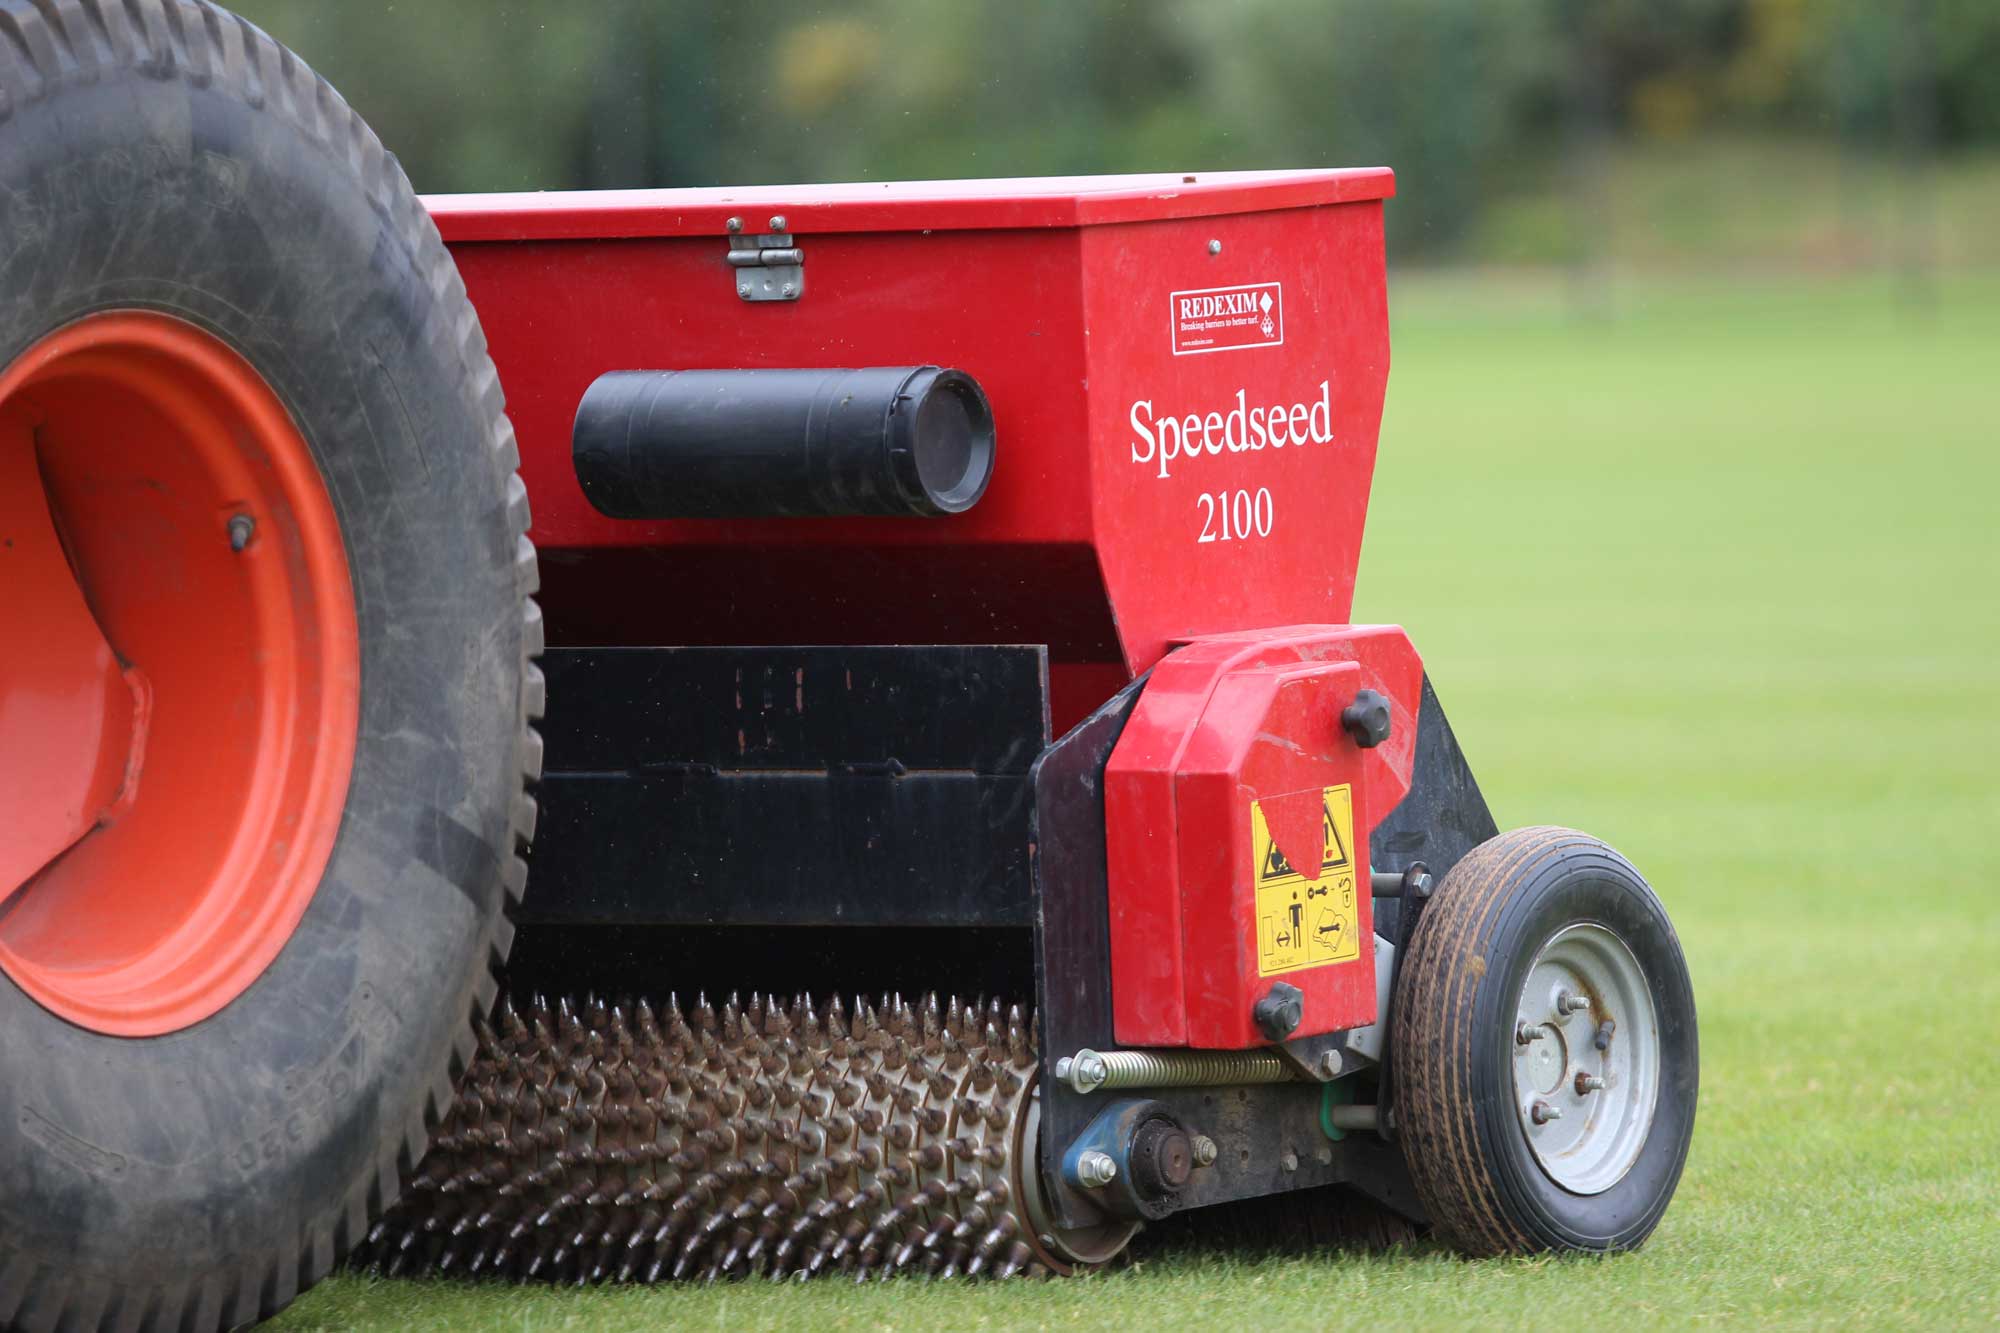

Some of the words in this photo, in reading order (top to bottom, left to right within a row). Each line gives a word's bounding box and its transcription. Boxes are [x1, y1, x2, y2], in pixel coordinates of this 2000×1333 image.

[1180, 291, 1258, 320] REDEXIM
[1225, 319, 1232, 327] to
[1129, 380, 1334, 478] Speedseed
[1197, 487, 1273, 544] 2100
